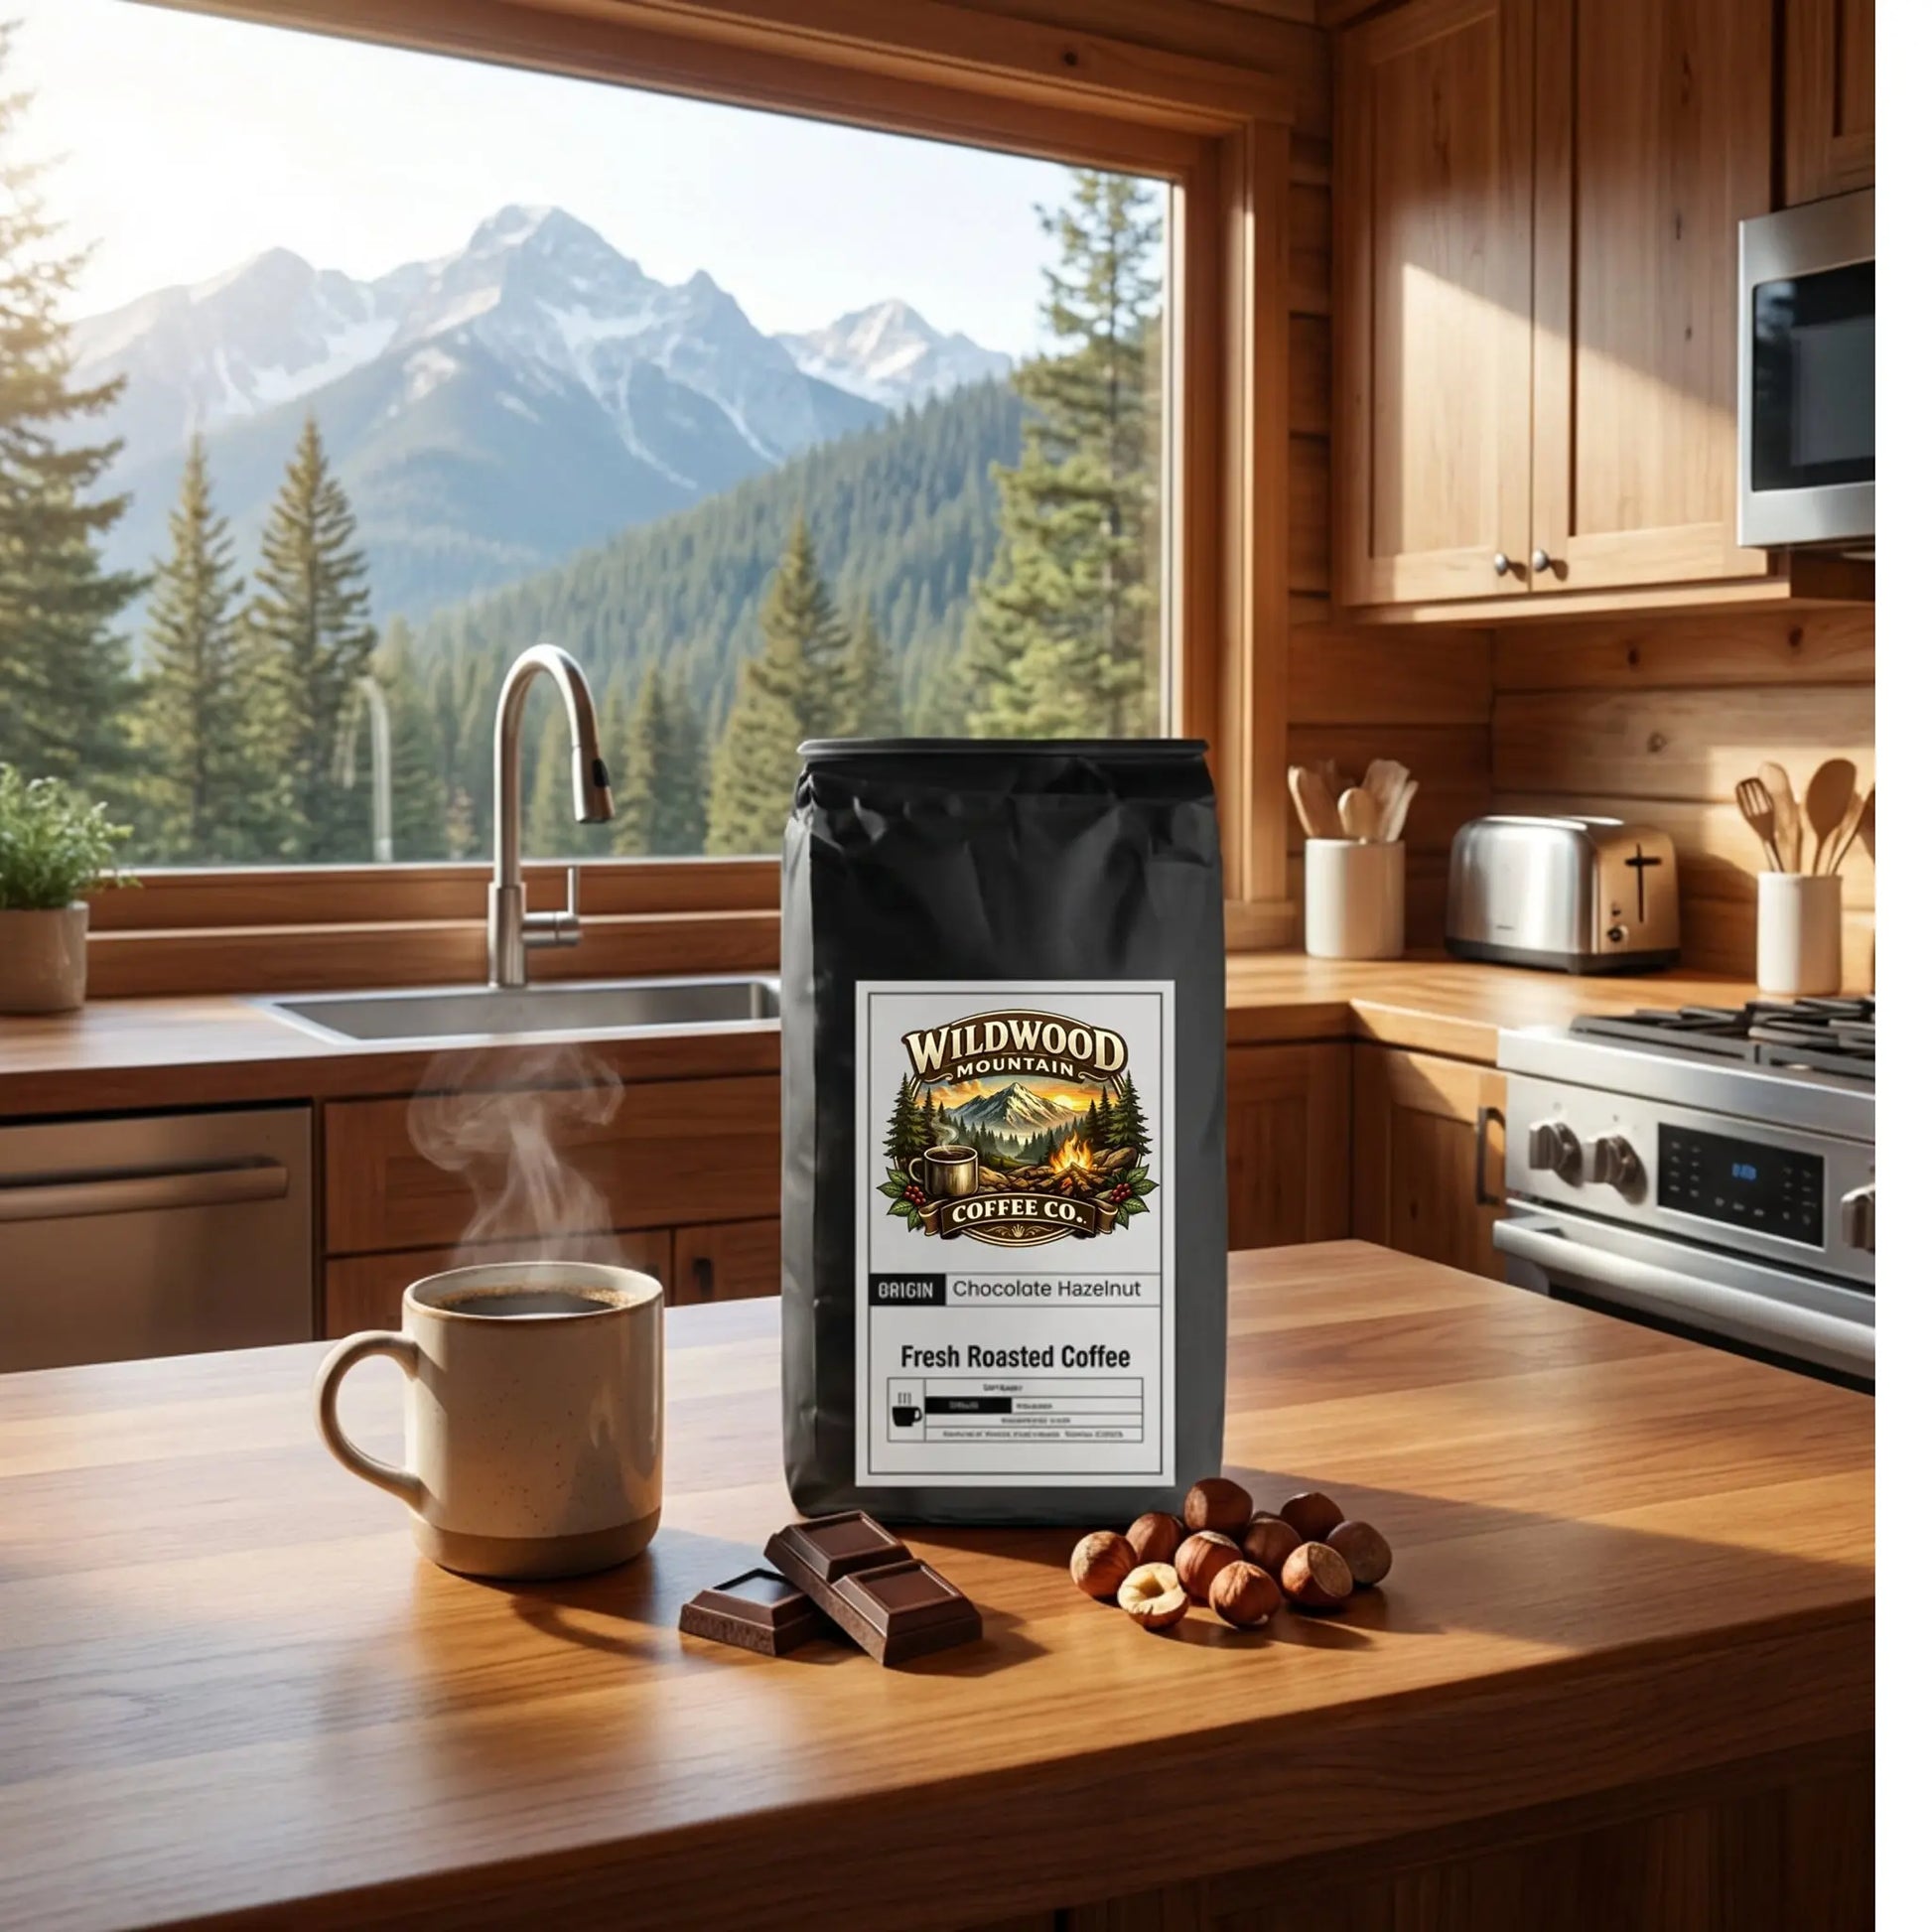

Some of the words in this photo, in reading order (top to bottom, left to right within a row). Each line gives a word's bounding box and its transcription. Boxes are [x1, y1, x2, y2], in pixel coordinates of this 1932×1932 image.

[905, 1020, 1126, 1074] WILDWOOD
[956, 1056, 1074, 1078] MOUNTAIN
[951, 1198, 1038, 1224] COFFEE
[878, 1281, 933, 1299] ORIGIN
[952, 1280, 1052, 1298] Chocolate
[1057, 1280, 1142, 1298] Hazelnut
[900, 1344, 960, 1369] Fresh
[967, 1344, 1054, 1369] Roasted
[1061, 1344, 1132, 1369] Coffee
